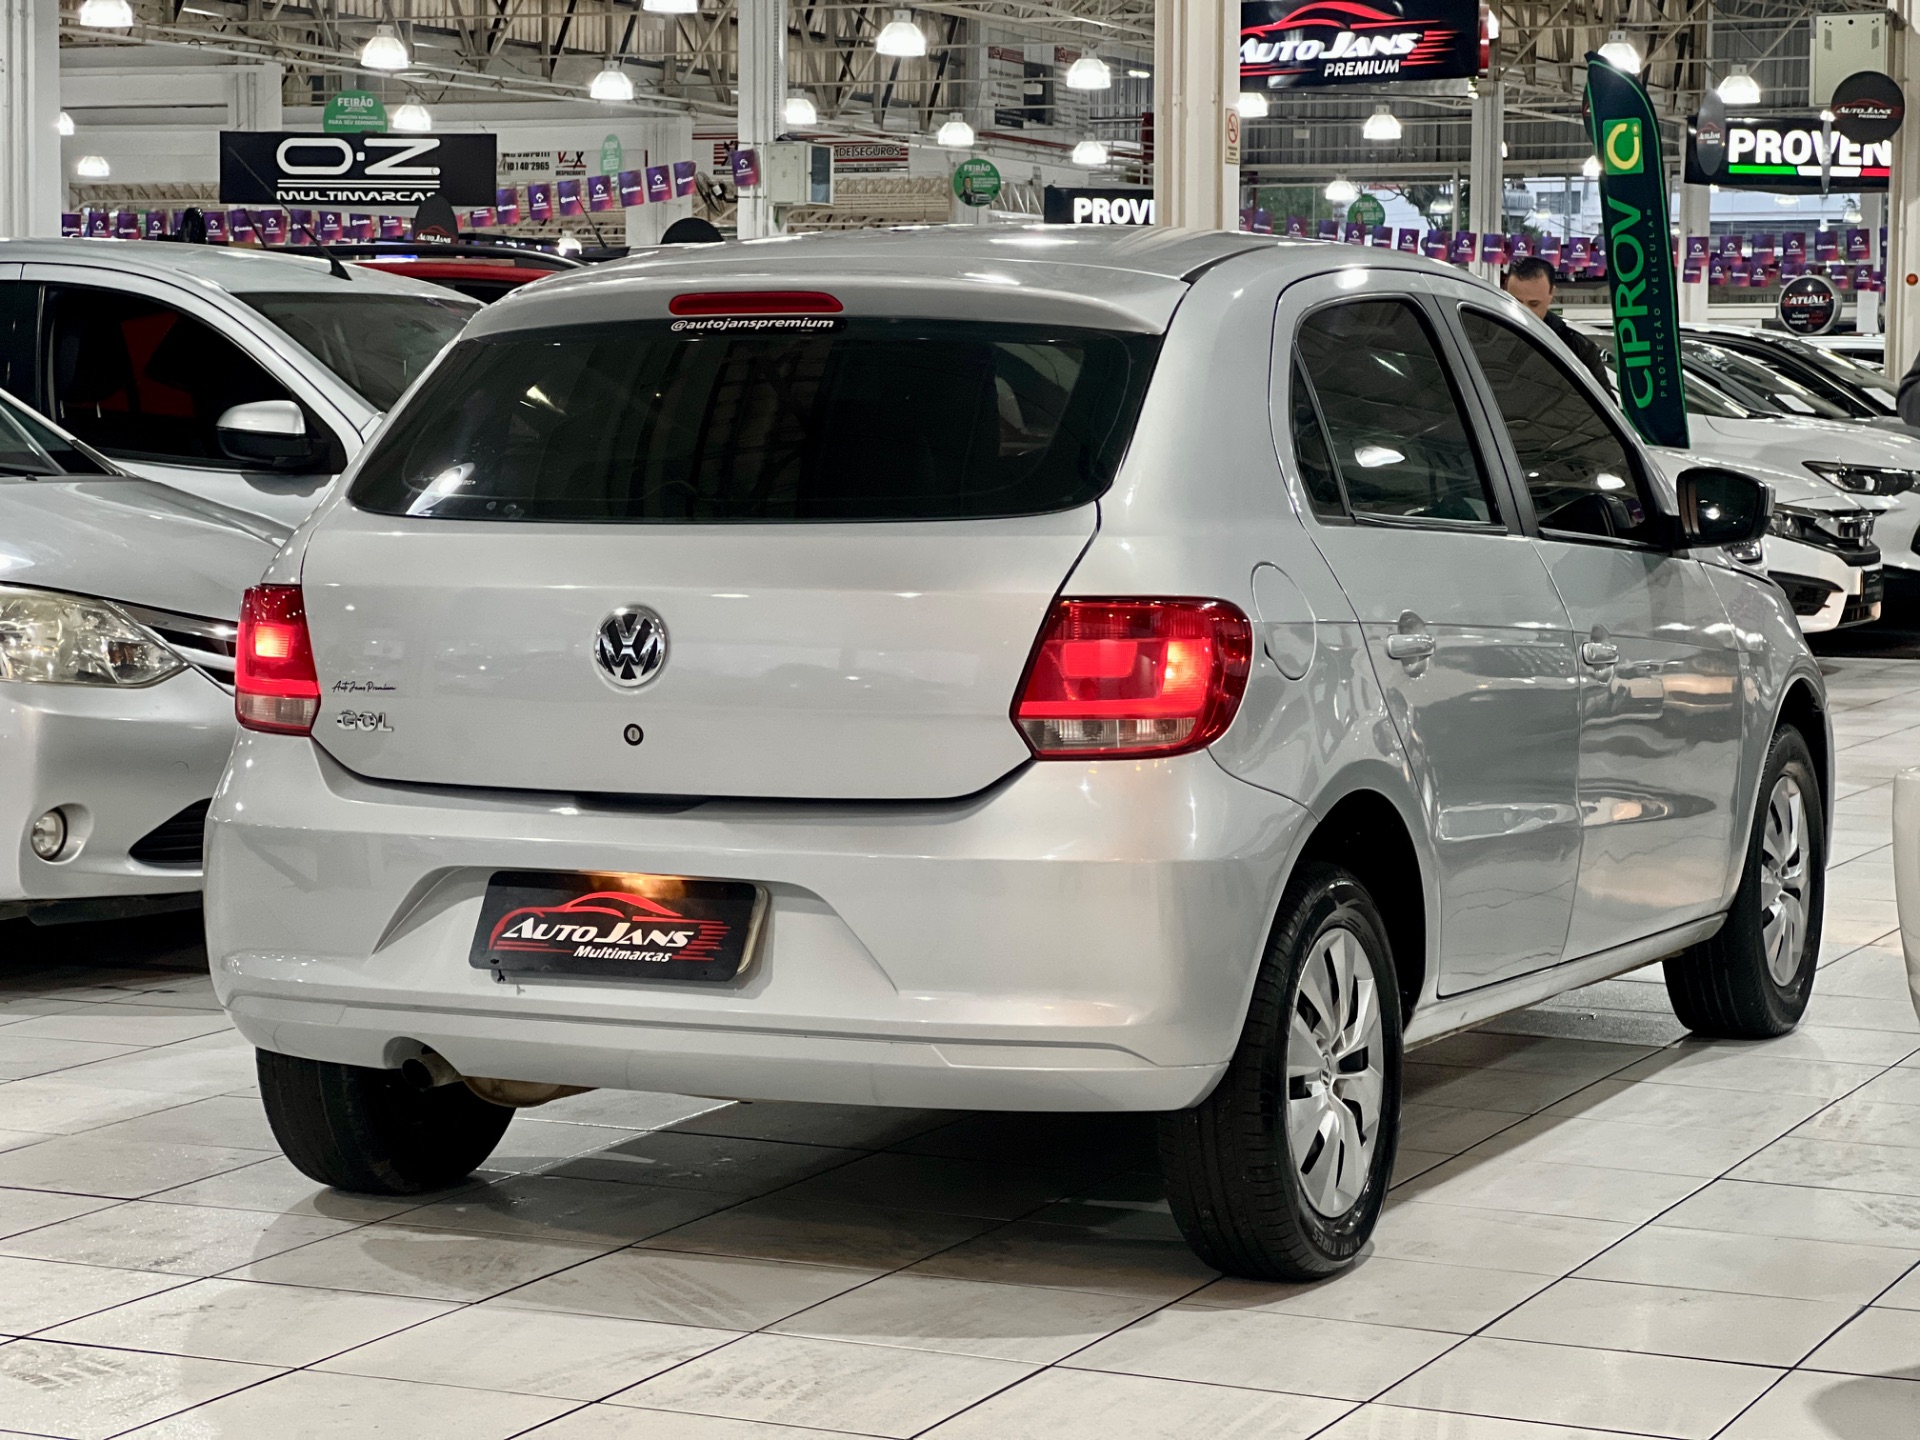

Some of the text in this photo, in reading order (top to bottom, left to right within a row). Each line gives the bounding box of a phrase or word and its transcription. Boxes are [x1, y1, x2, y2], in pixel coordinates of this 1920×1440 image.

[1324, 59, 1400, 77] PREMIUM
[337, 96, 374, 107] FEIRÃO
[855, 146, 901, 157] SEGUROS
[1606, 194, 1655, 410] CIPROV
[1646, 209, 1668, 398] PROTEÇÃO VEICULAR
[1789, 295, 1826, 305] ATUAL
[670, 317, 835, 332] @autojanspremium
[336, 710, 394, 732] GOL
[573, 945, 673, 963] Multimarcas
